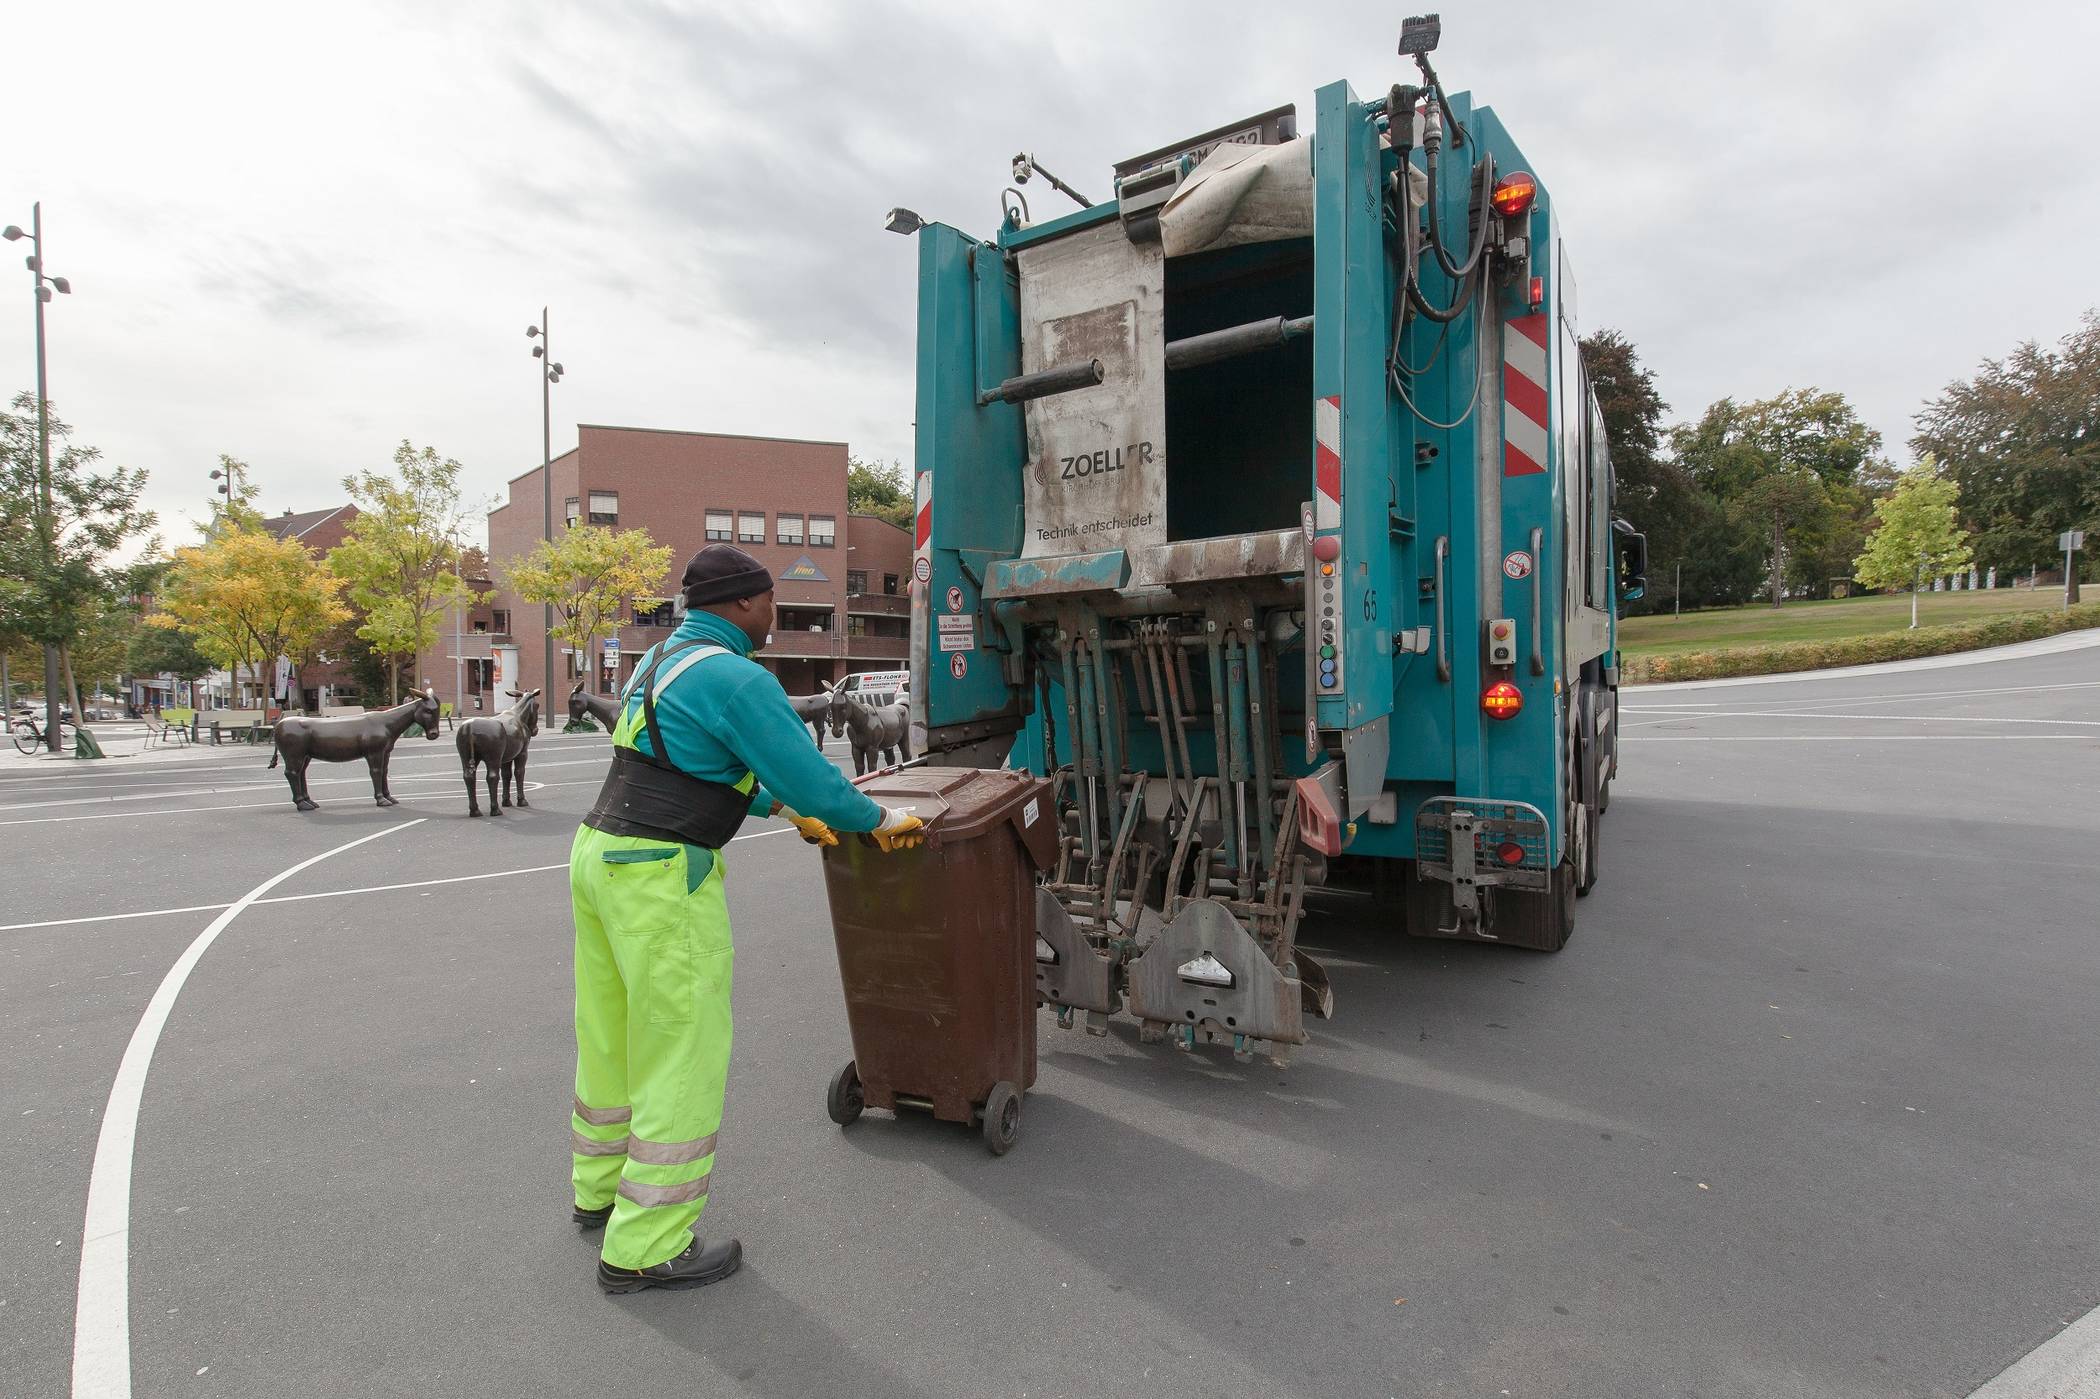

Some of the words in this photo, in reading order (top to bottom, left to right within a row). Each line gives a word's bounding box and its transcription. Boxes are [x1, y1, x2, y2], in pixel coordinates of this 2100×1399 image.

[1037, 523, 1079, 541] Technik
[1081, 513, 1153, 535] entscheidet
[1363, 588, 1378, 621] 65
